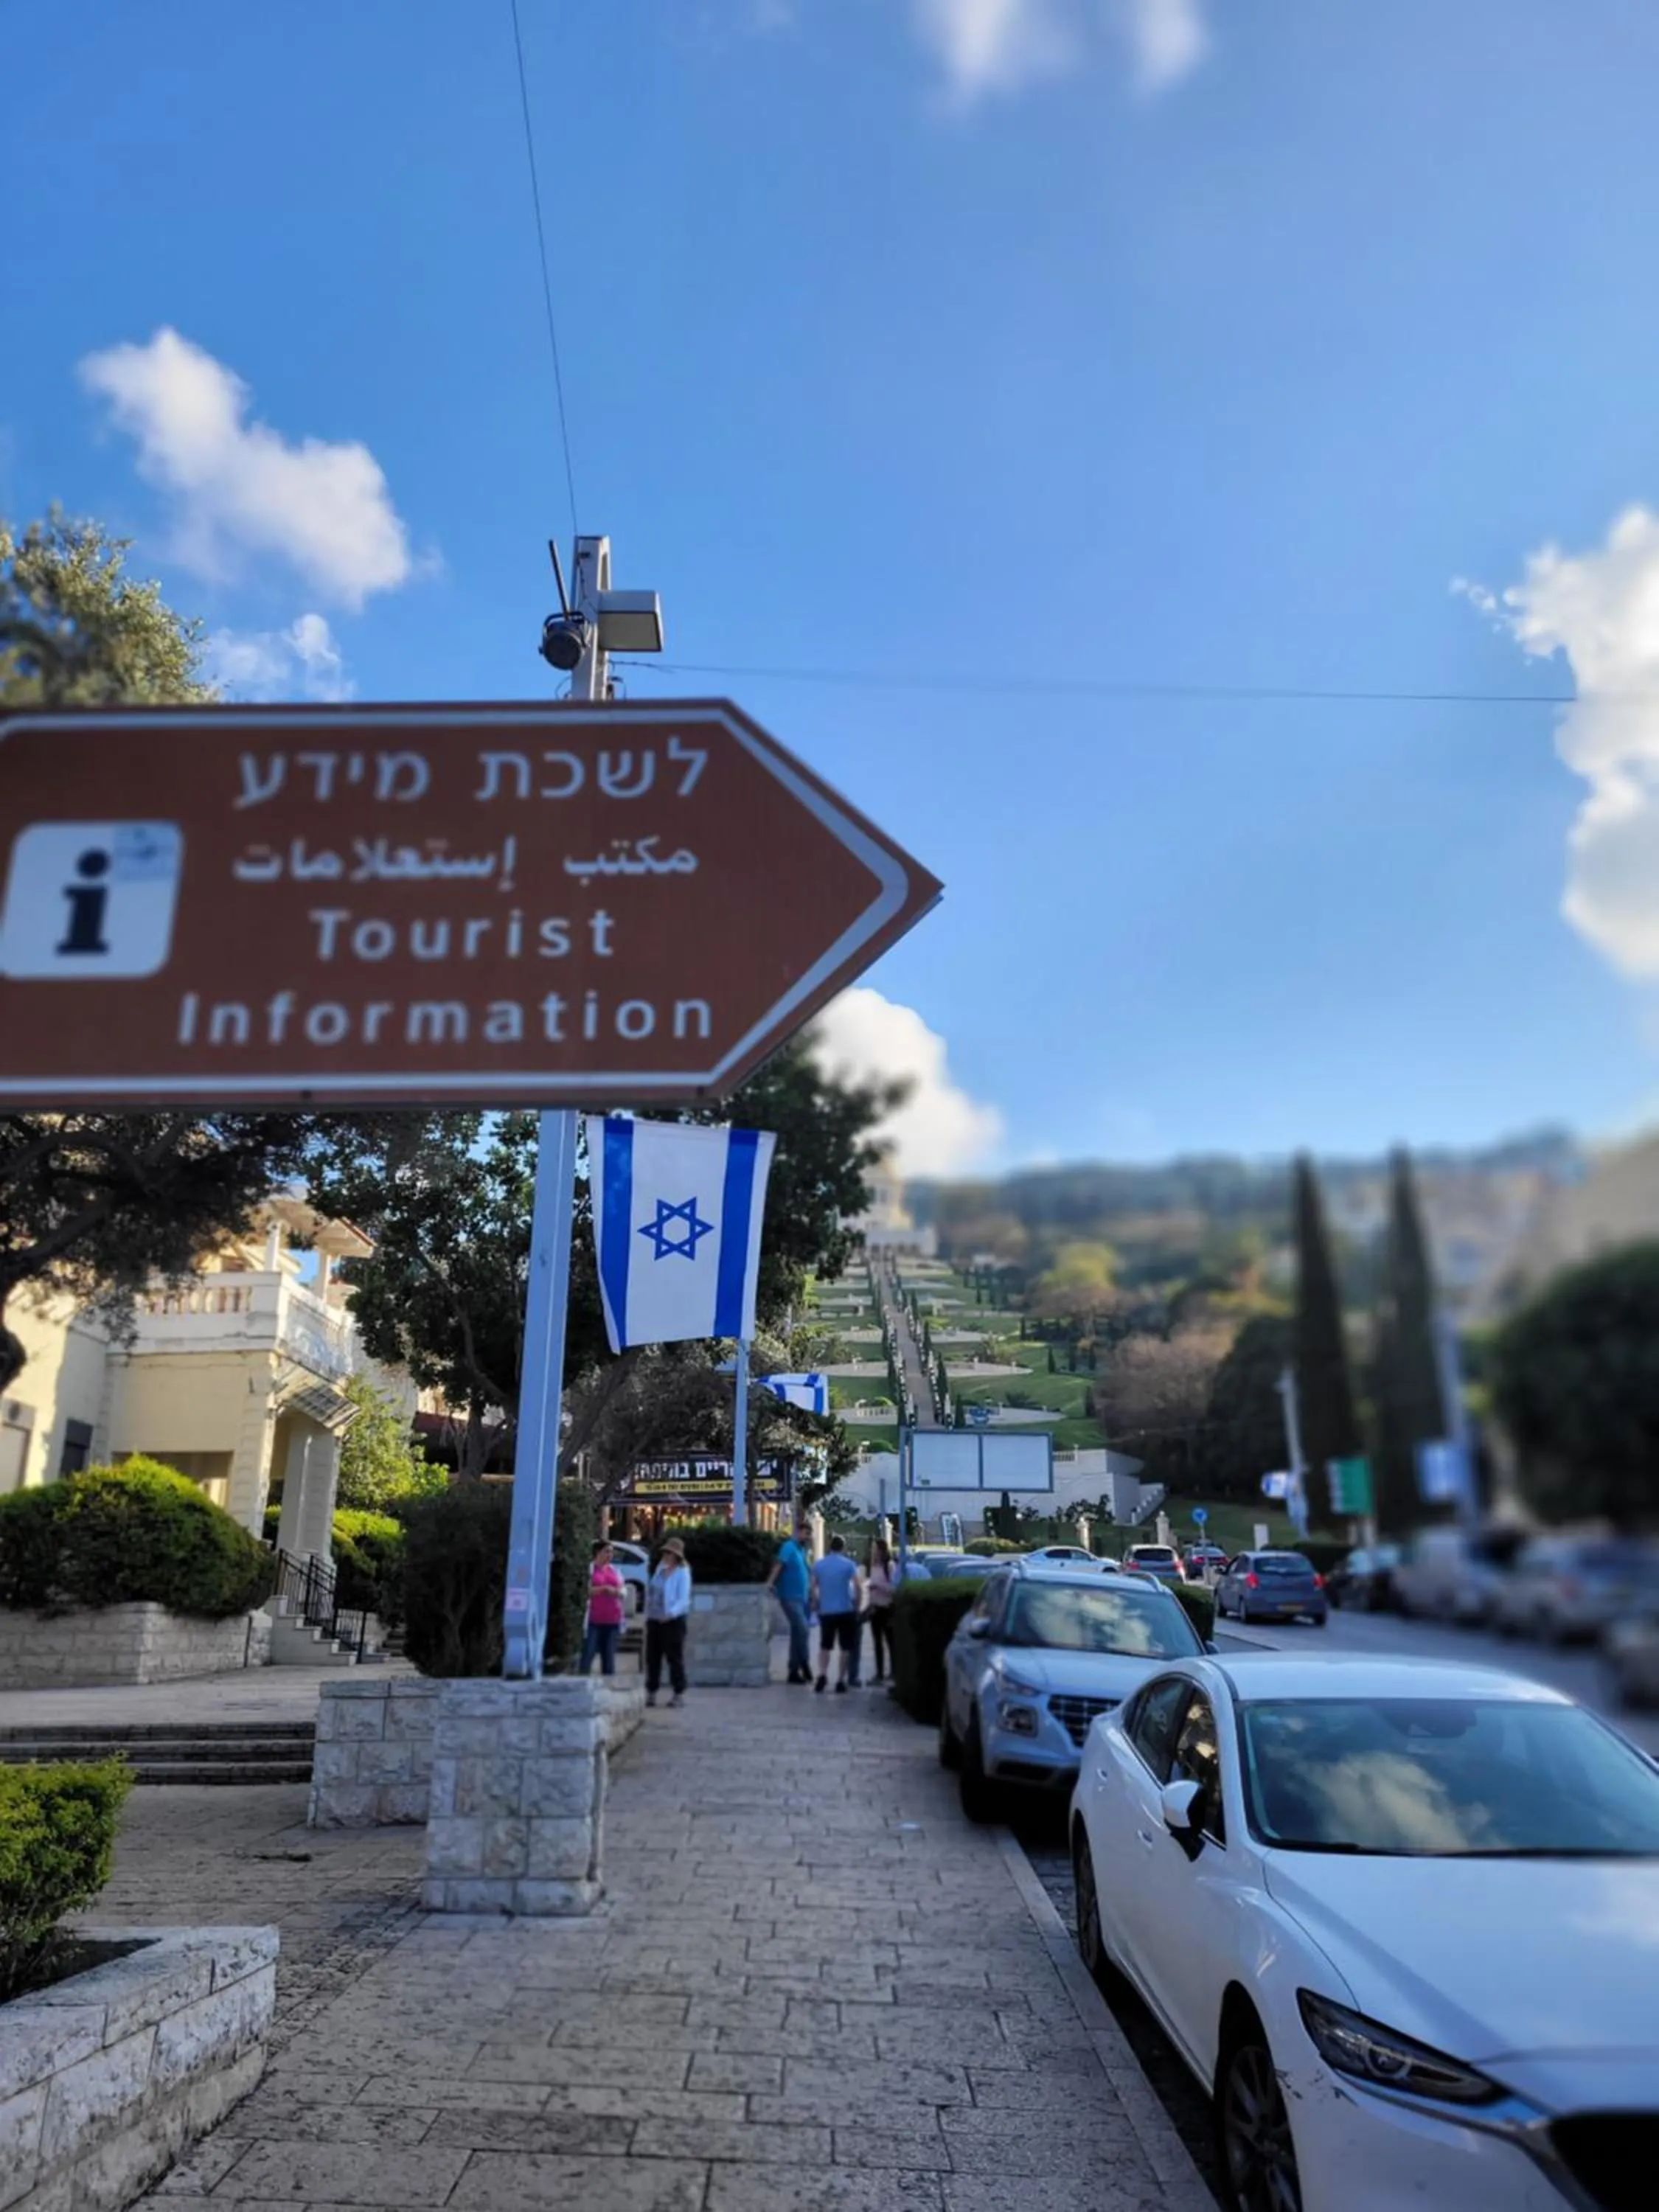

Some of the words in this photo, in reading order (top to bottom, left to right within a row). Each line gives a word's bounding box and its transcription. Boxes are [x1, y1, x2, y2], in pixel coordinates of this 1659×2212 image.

[233, 751, 431, 808] מידע
[475, 737, 709, 801] לשכת
[563, 835, 699, 886] مكتب
[309, 909, 615, 959] Tourist
[177, 991, 712, 1045] Information
